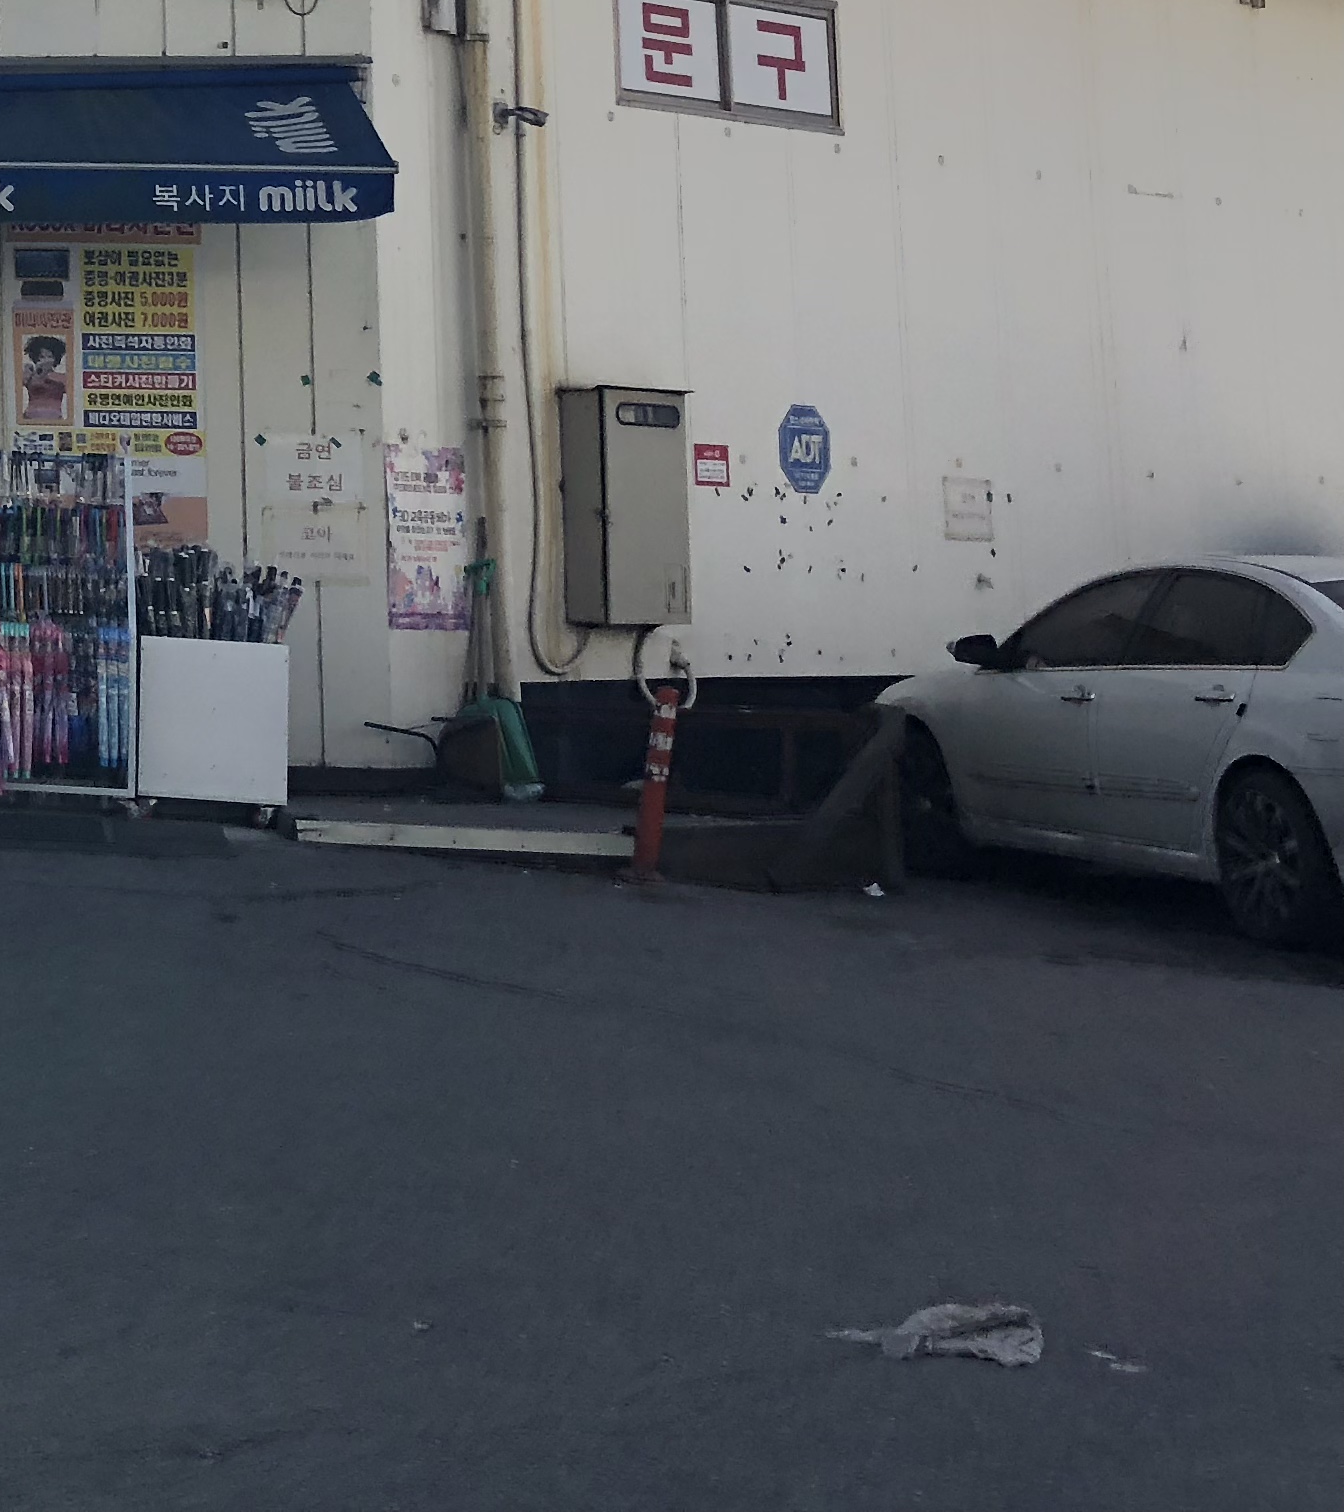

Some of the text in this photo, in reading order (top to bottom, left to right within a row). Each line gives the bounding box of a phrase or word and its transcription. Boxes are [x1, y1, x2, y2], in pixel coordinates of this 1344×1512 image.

[642, 2, 806, 100] 문구
[152, 183, 247, 213] 복사지
[258, 179, 359, 214] miilk
[295, 441, 333, 461] 금연
[788, 434, 823, 463] ADT
